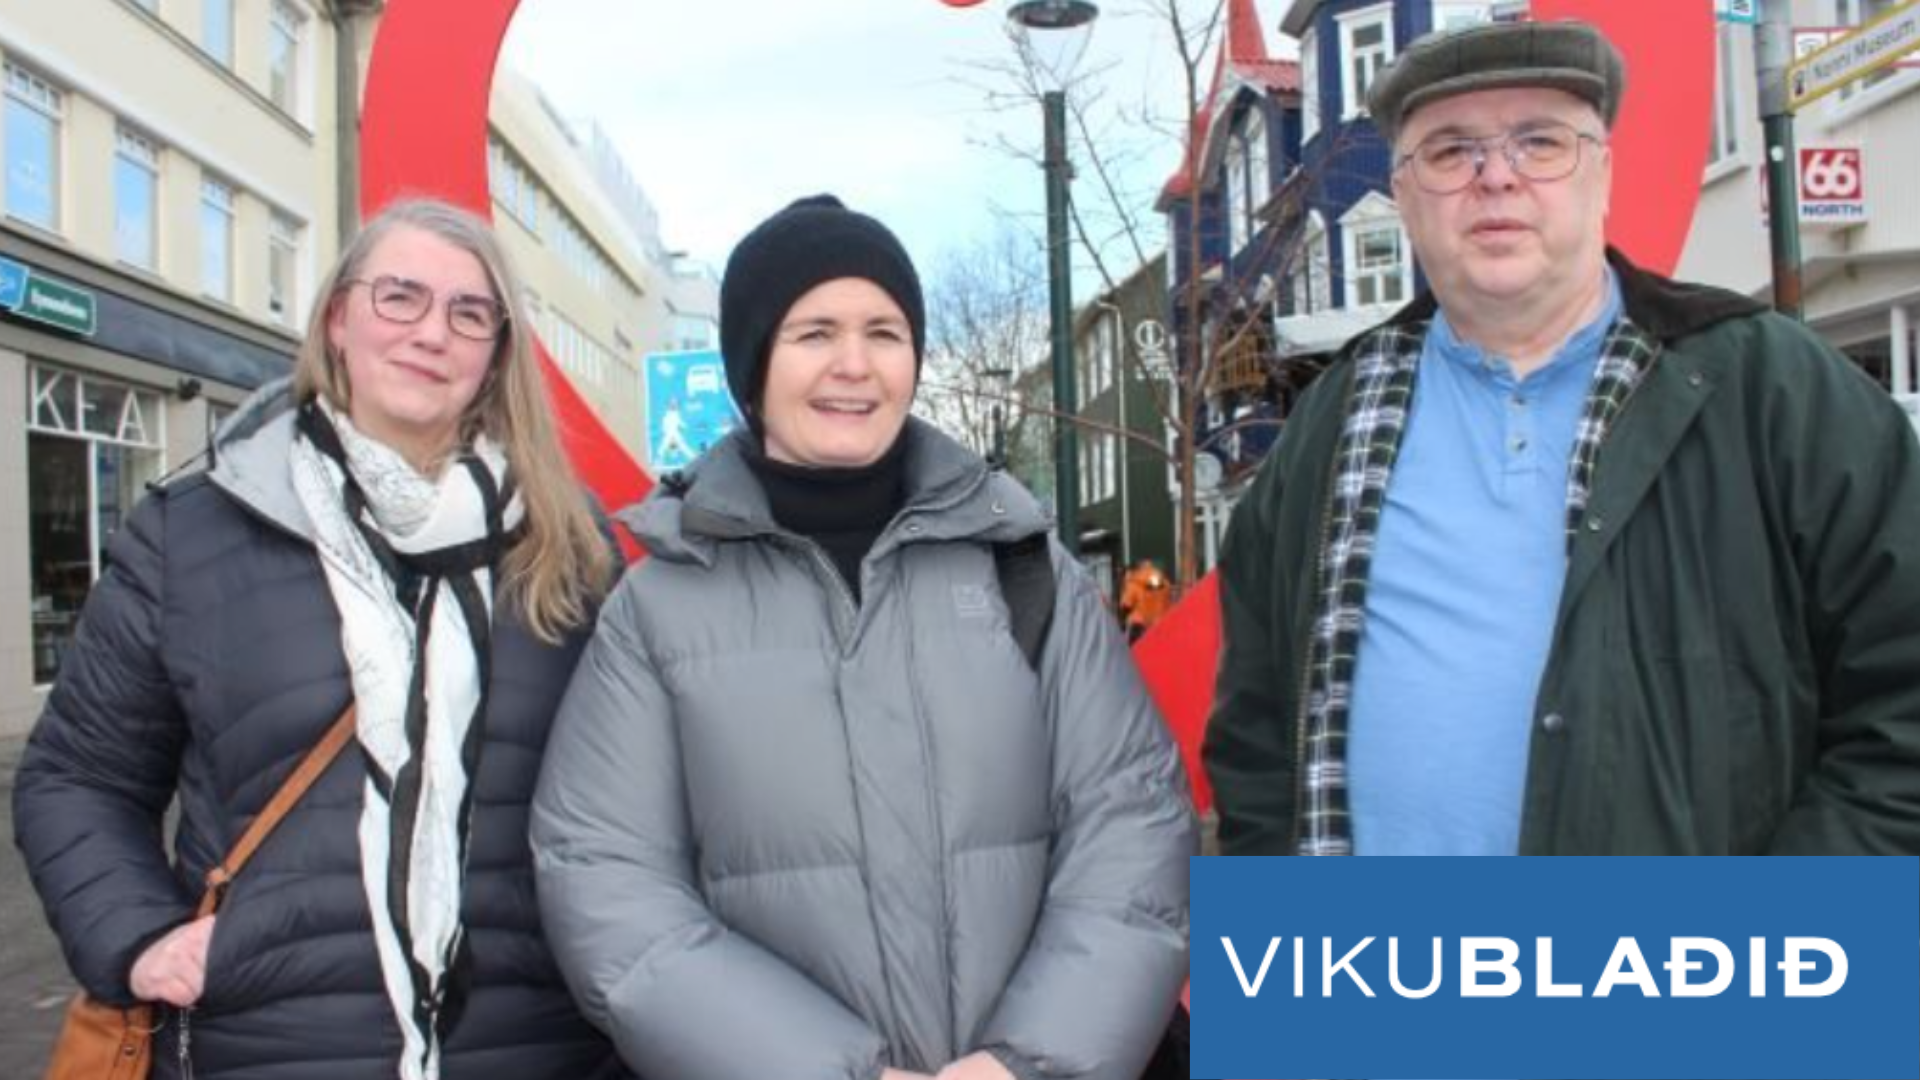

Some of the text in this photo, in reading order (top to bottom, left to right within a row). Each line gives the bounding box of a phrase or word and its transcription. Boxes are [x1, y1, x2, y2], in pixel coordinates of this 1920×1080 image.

[1854, 19, 1916, 57] Museum
[1803, 204, 1863, 216] NORTH
[31, 364, 148, 446] KEA
